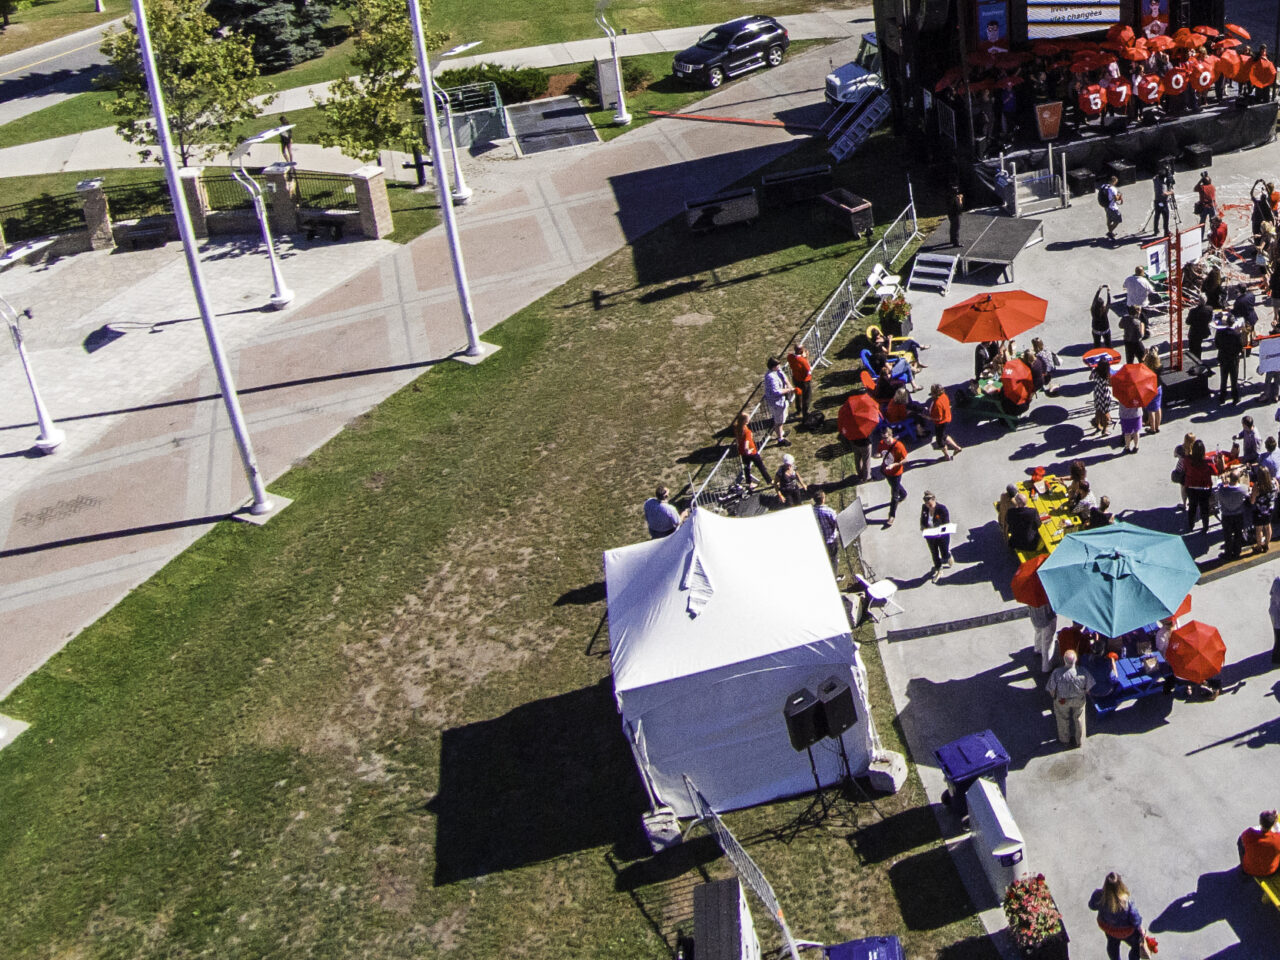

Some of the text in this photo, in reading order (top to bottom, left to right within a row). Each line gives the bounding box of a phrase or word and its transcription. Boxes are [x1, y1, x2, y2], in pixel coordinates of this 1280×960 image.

[1088, 71, 1212, 110] 5 7 2 0 0
